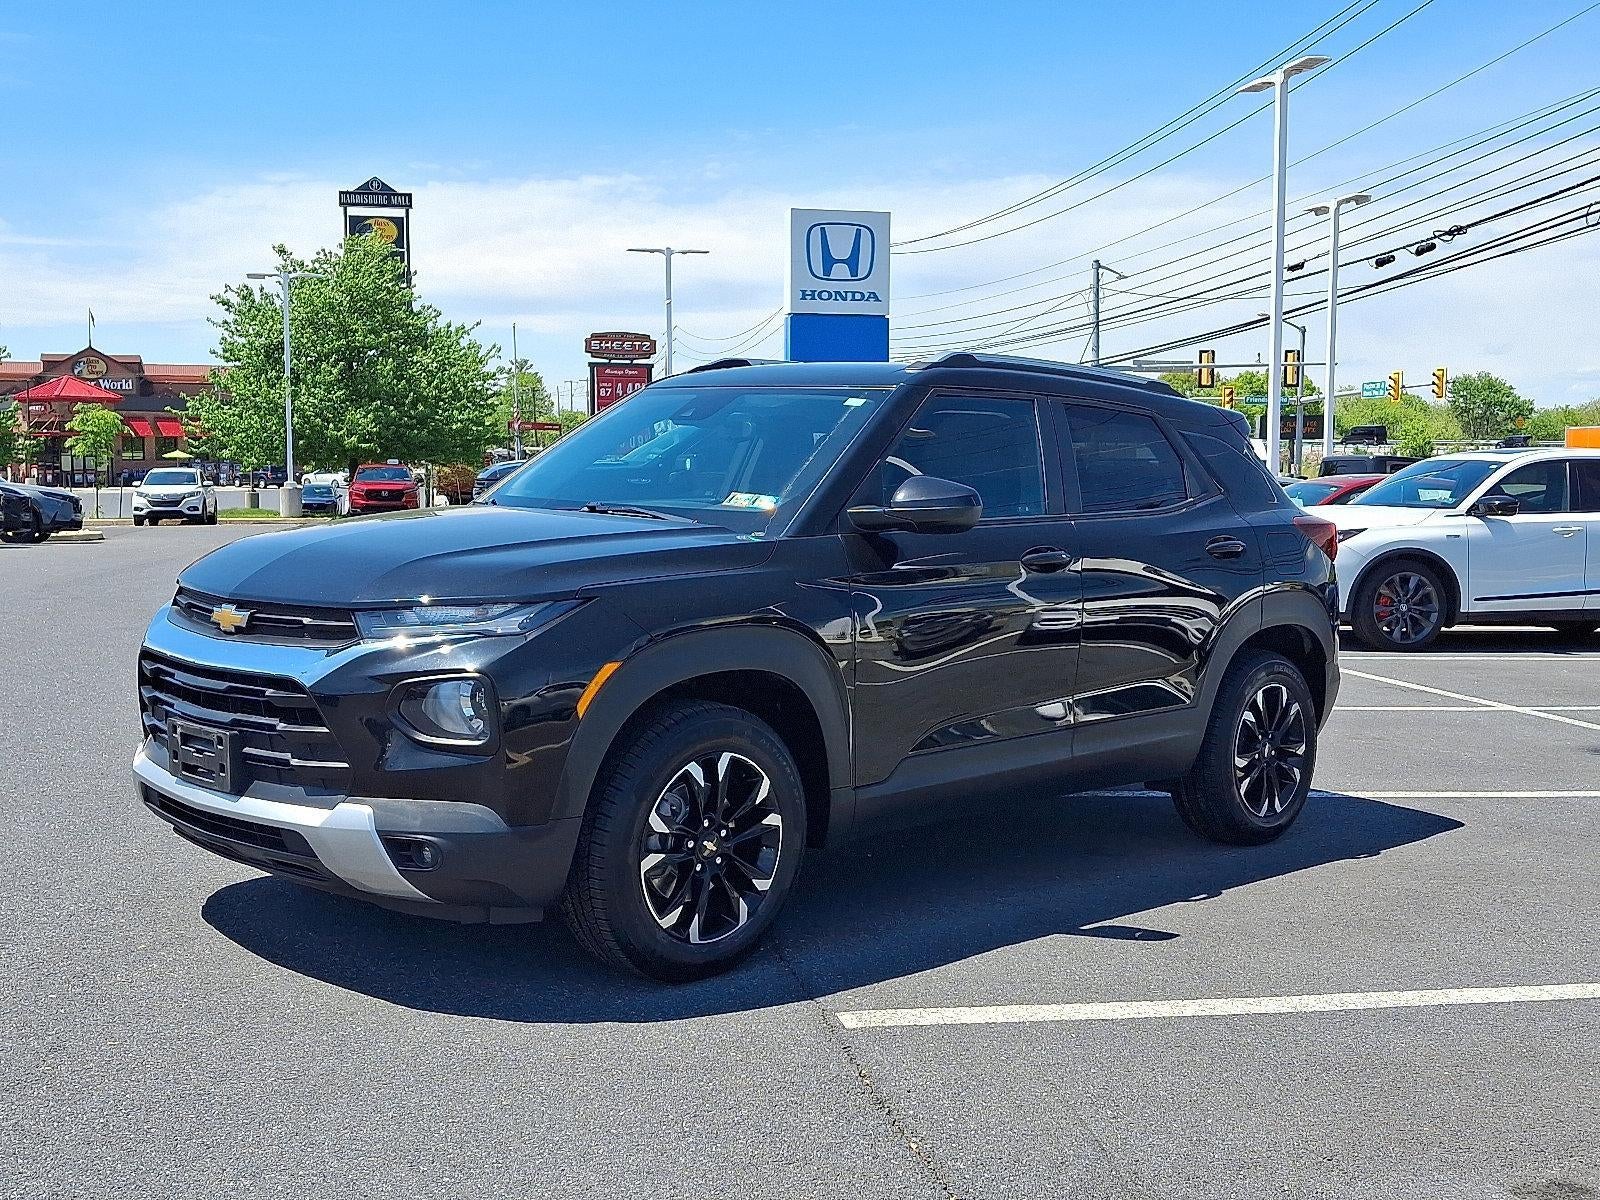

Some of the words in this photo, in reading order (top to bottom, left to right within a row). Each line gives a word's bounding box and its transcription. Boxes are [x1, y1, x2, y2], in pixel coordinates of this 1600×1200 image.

[341, 193, 388, 204] HARRISBURG
[391, 195, 410, 205] MALL
[799, 289, 882, 302] HONDA
[590, 340, 651, 351] SHEETZ
[98, 379, 133, 390] World
[600, 388, 612, 397] 87
